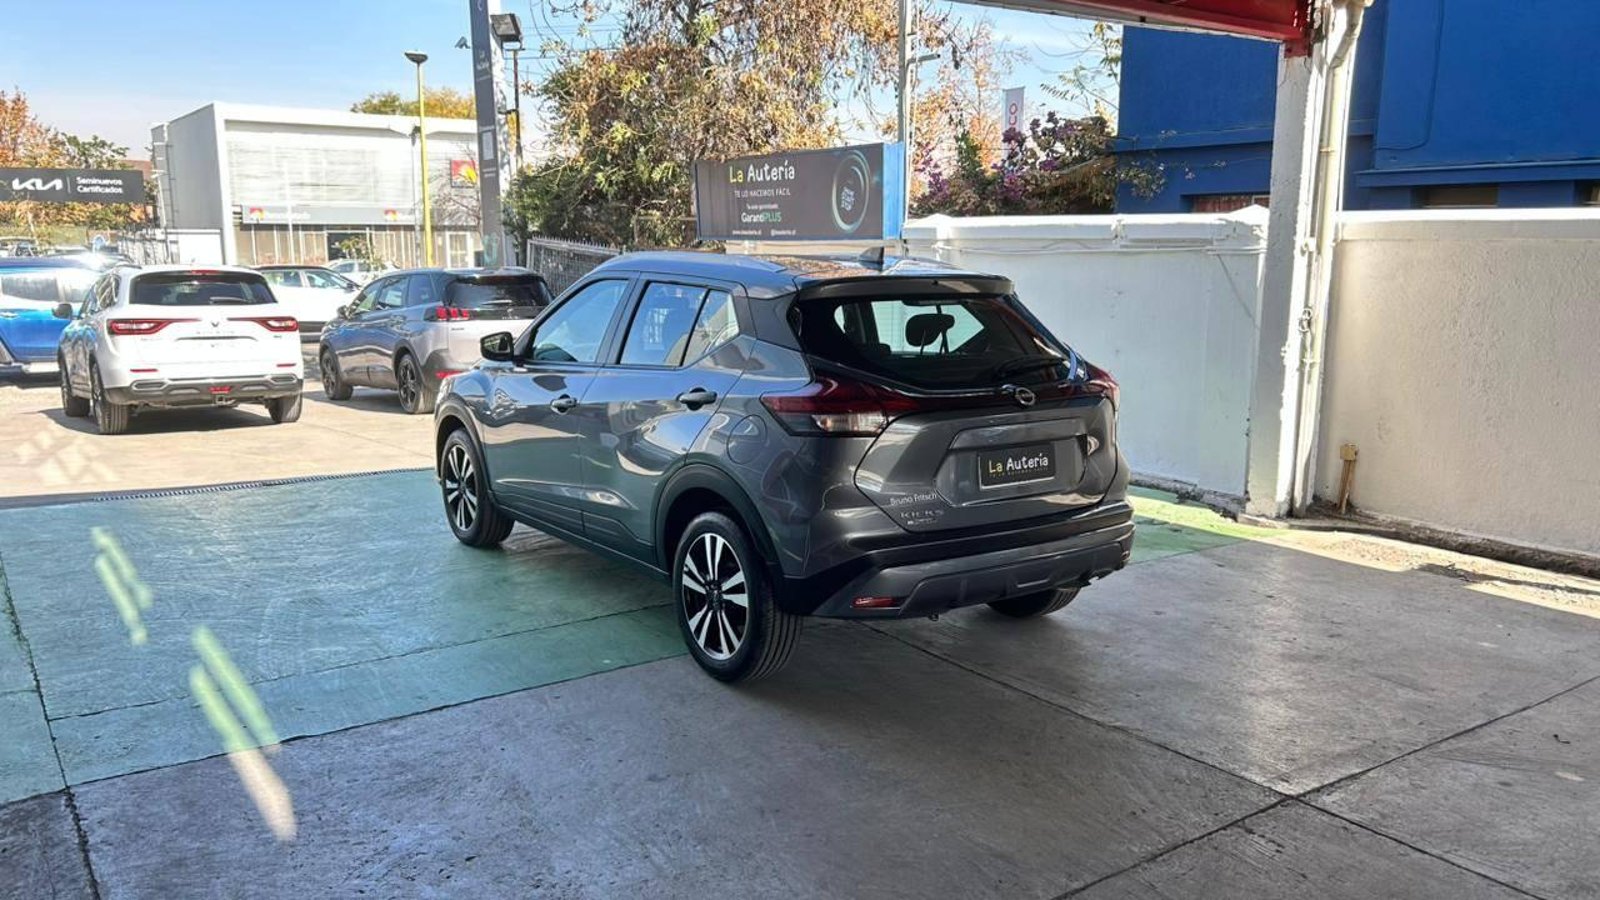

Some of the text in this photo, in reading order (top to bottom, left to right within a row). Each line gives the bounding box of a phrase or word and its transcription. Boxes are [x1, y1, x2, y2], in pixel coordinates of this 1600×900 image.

[729, 160, 795, 183] La Autería
[12, 178, 63, 190] KIA
[76, 176, 123, 185] Seminuevos
[77, 185, 123, 193] Certificados
[988, 460, 1003, 473] La
[1006, 453, 1049, 471] Autería
[890, 493, 937, 506] Bruno Fritsch
